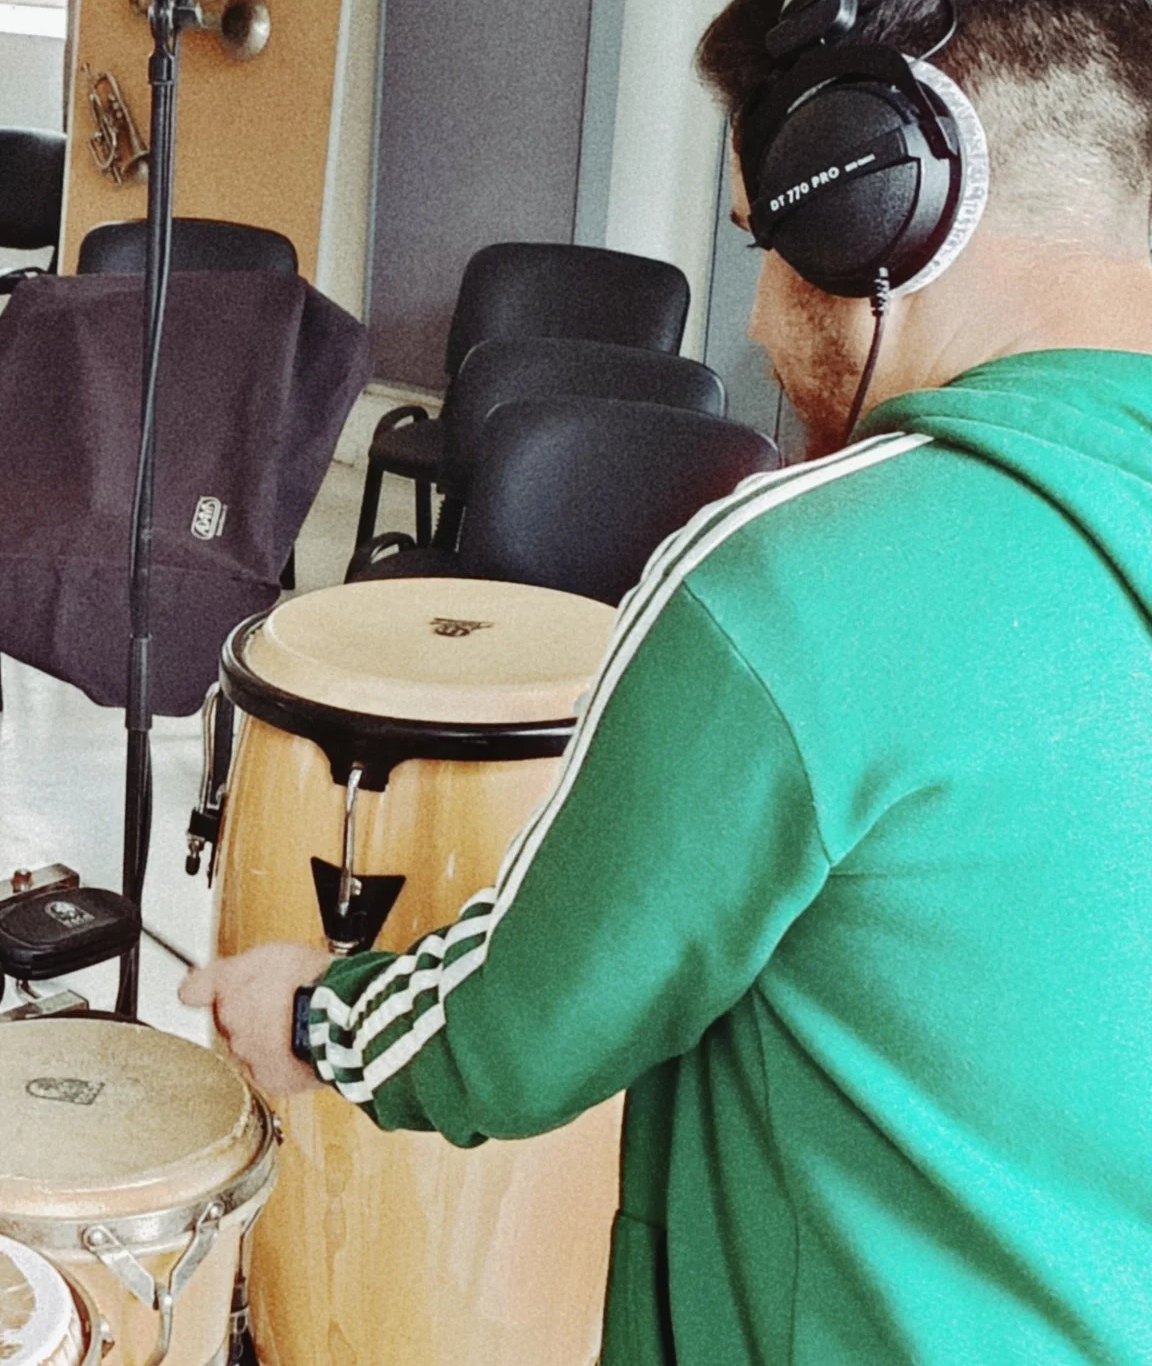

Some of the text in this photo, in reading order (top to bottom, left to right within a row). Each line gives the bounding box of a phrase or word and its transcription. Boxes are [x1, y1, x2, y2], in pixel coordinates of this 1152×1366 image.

[769, 166, 840, 212] DT 770 PRO
